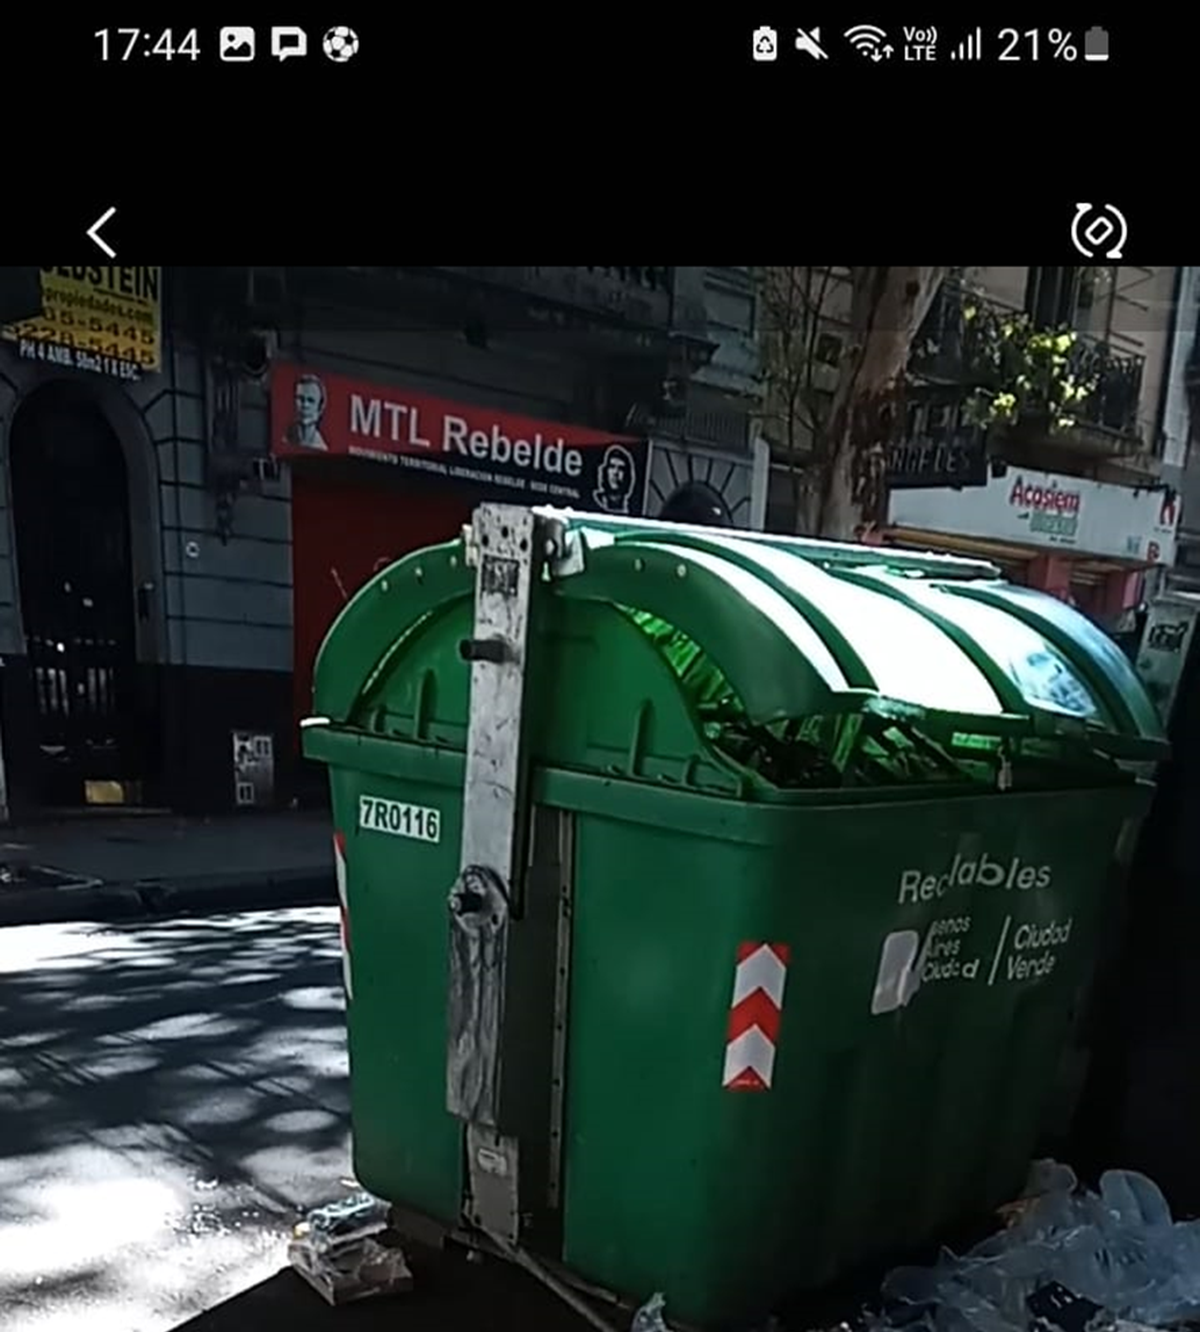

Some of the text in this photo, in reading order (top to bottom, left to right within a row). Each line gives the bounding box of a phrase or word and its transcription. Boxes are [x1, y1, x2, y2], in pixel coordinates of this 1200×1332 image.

[350, 394, 583, 476] MTL Rebelde
[362, 799, 437, 839] 7R0116
[1014, 917, 1073, 950] Ciudad
